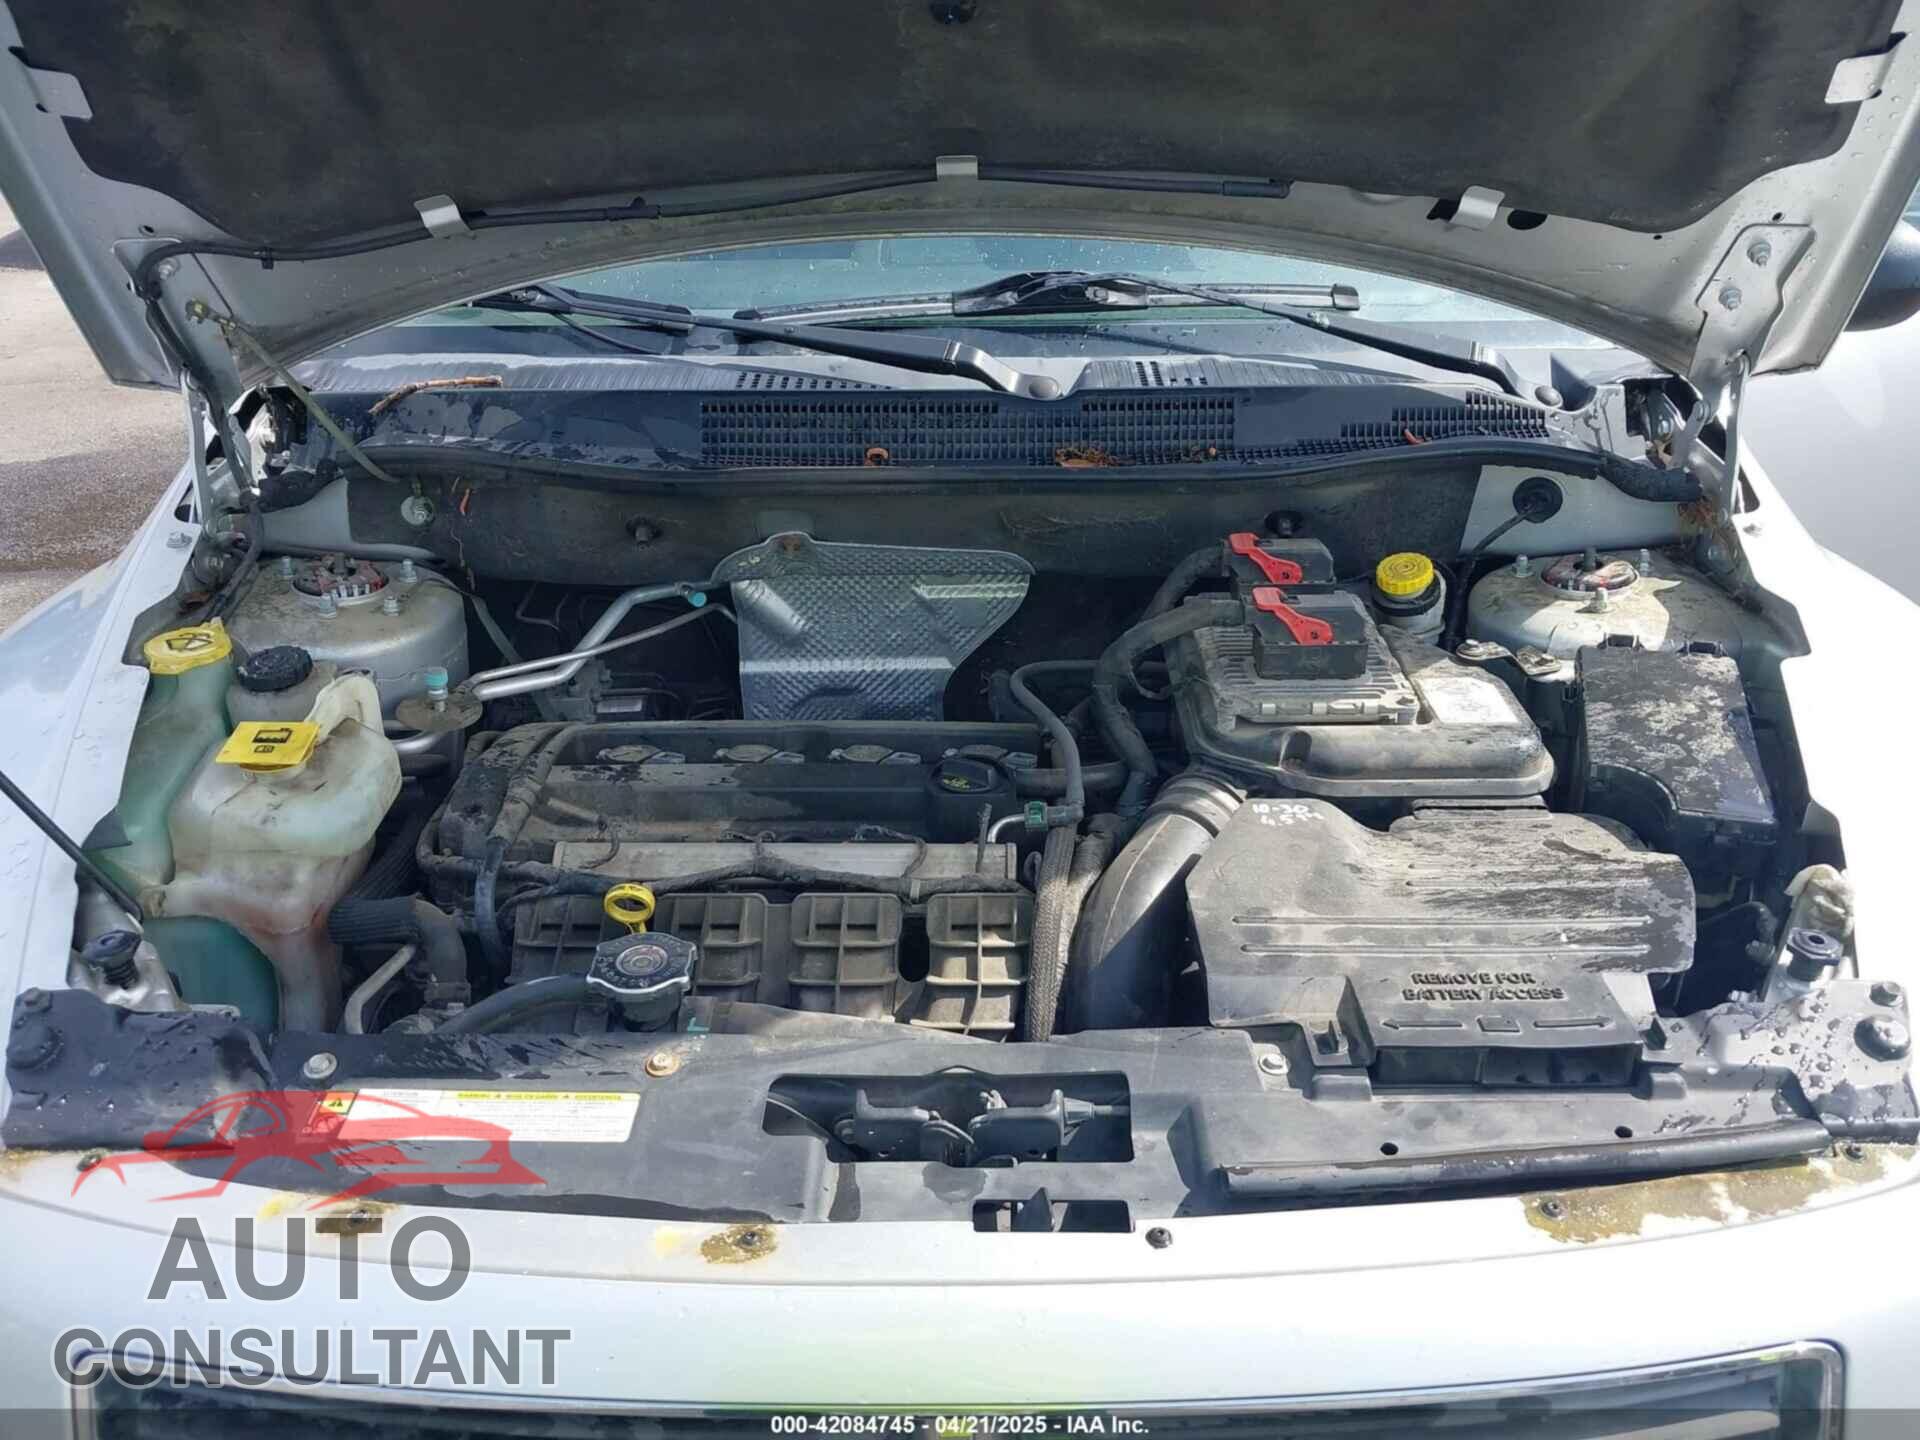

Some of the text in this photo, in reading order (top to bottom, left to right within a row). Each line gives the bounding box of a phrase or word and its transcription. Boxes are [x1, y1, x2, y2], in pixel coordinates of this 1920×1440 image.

[1411, 972, 1537, 985] REMOVE FOR
[1401, 988, 1565, 1001] BATTERY ACCESS
